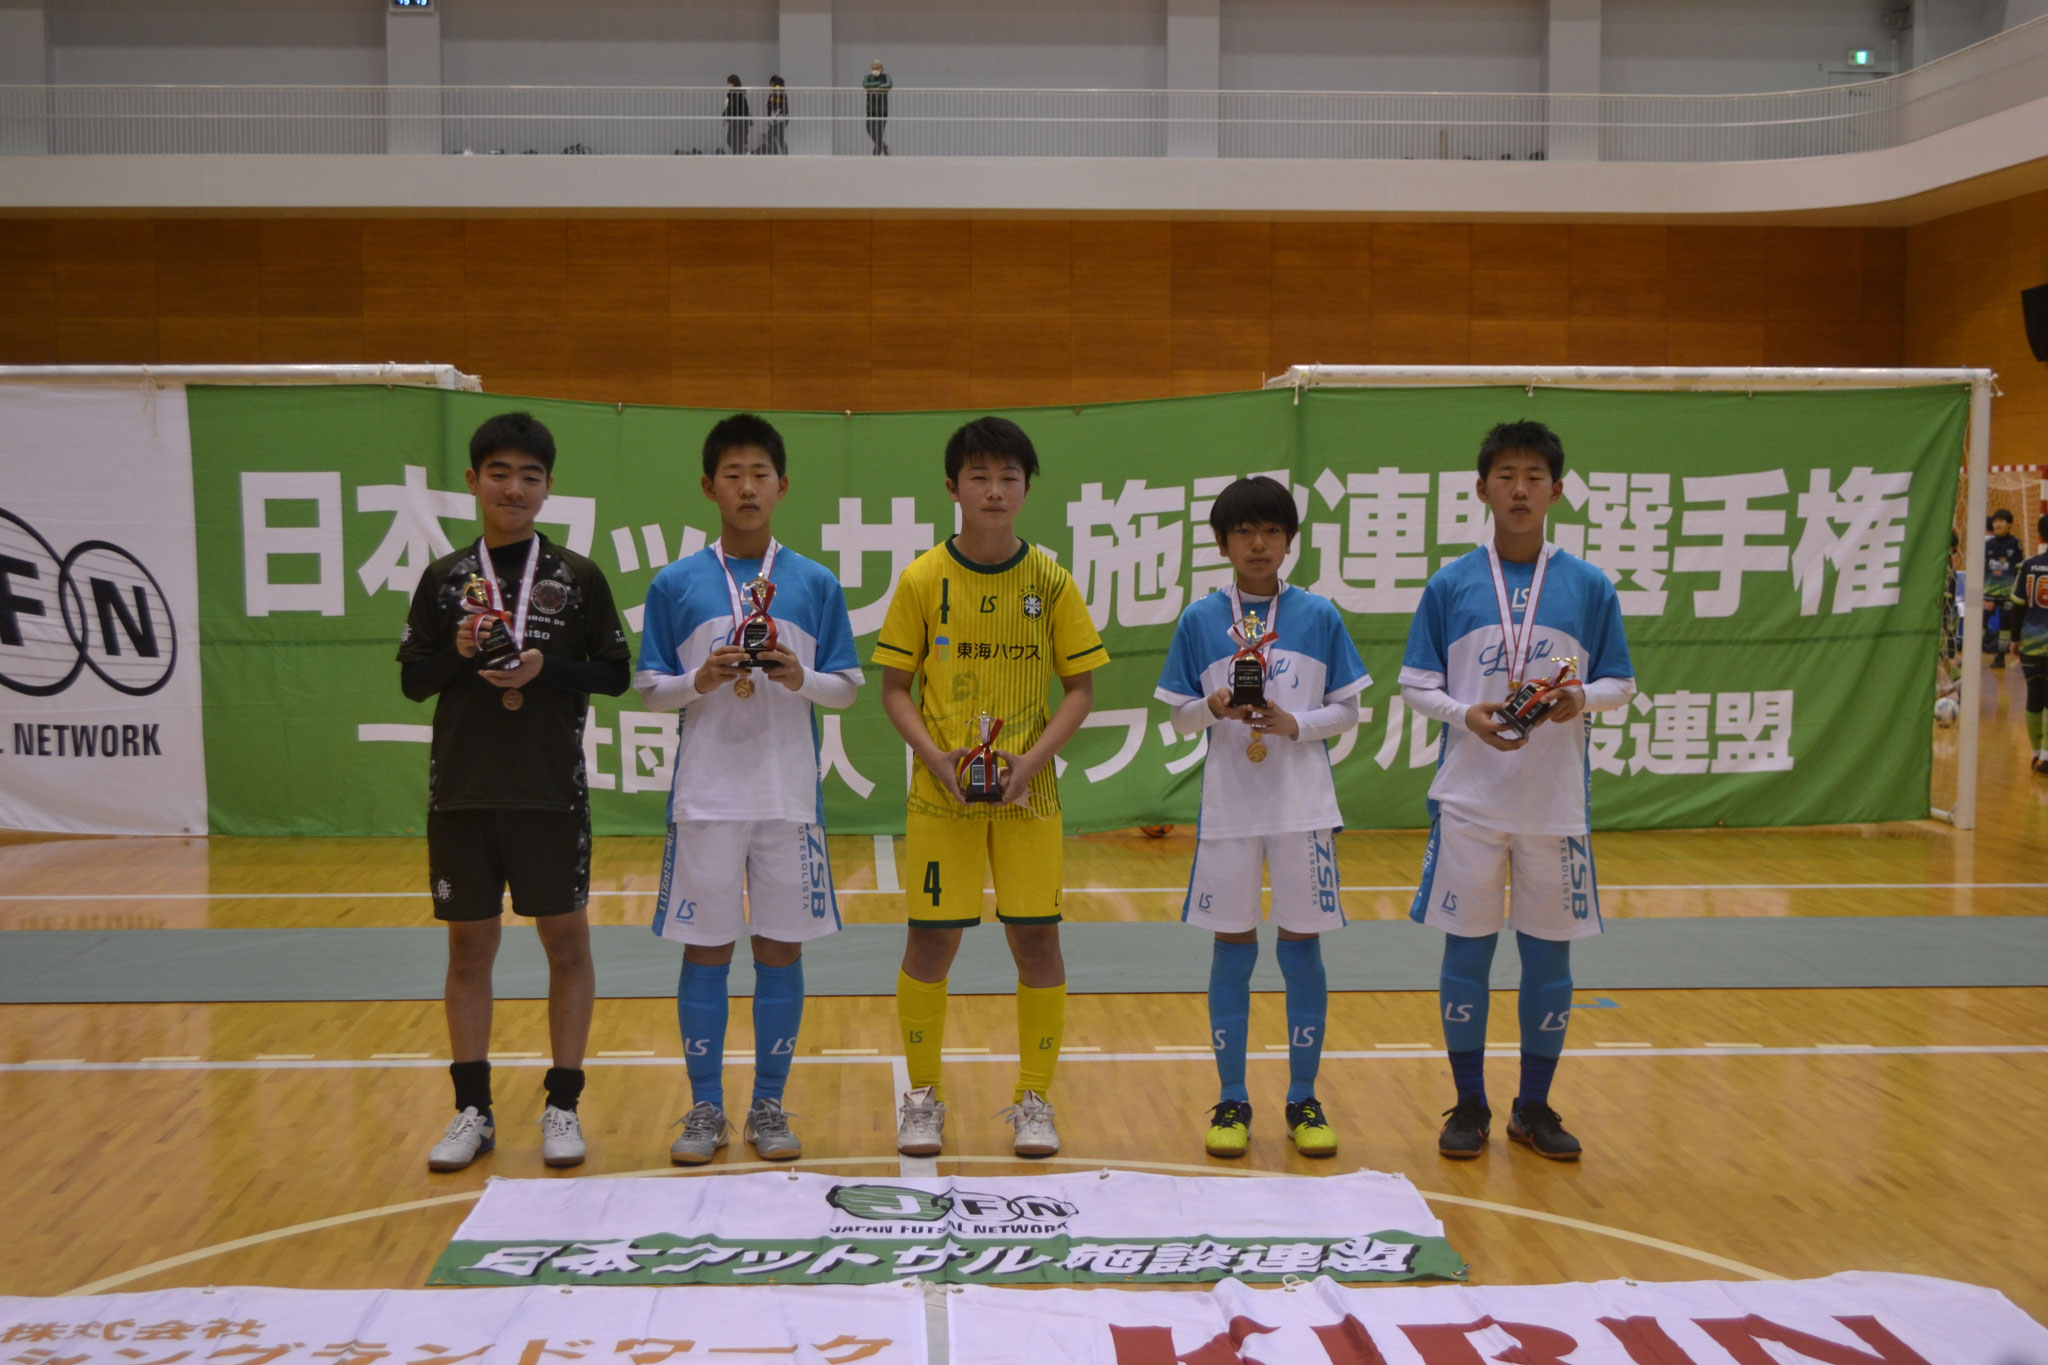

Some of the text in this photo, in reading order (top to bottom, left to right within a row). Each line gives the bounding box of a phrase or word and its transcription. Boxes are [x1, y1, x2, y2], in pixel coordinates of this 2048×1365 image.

[979, 595, 998, 613] LS
[957, 642, 1042, 660] 東海ハウス
[14, 723, 162, 757] NETWORK
[798, 826, 809, 910] UTEBOLISTA
[806, 823, 826, 919] ZSB
[1313, 830, 1336, 913] ZSB
[1559, 838, 1569, 911] TEBOLISTA
[1567, 835, 1588, 920] ZSB
[923, 861, 942, 906] 4
[676, 898, 697, 920] LS
[1198, 892, 1213, 909] LS
[1441, 890, 1458, 911] LS
[1445, 1002, 1474, 1022] LS
[1539, 1011, 1570, 1031] LS
[684, 1038, 711, 1056] LS
[770, 1037, 797, 1055] LS
[909, 1030, 924, 1043] LS
[1039, 1037, 1053, 1049] LS
[1213, 1029, 1226, 1050] S
[1292, 1026, 1316, 1047] LS
[830, 1221, 1068, 1234] JAPAN FUTSAL NETWORK
[0, 1317, 266, 1343] 株式会社
